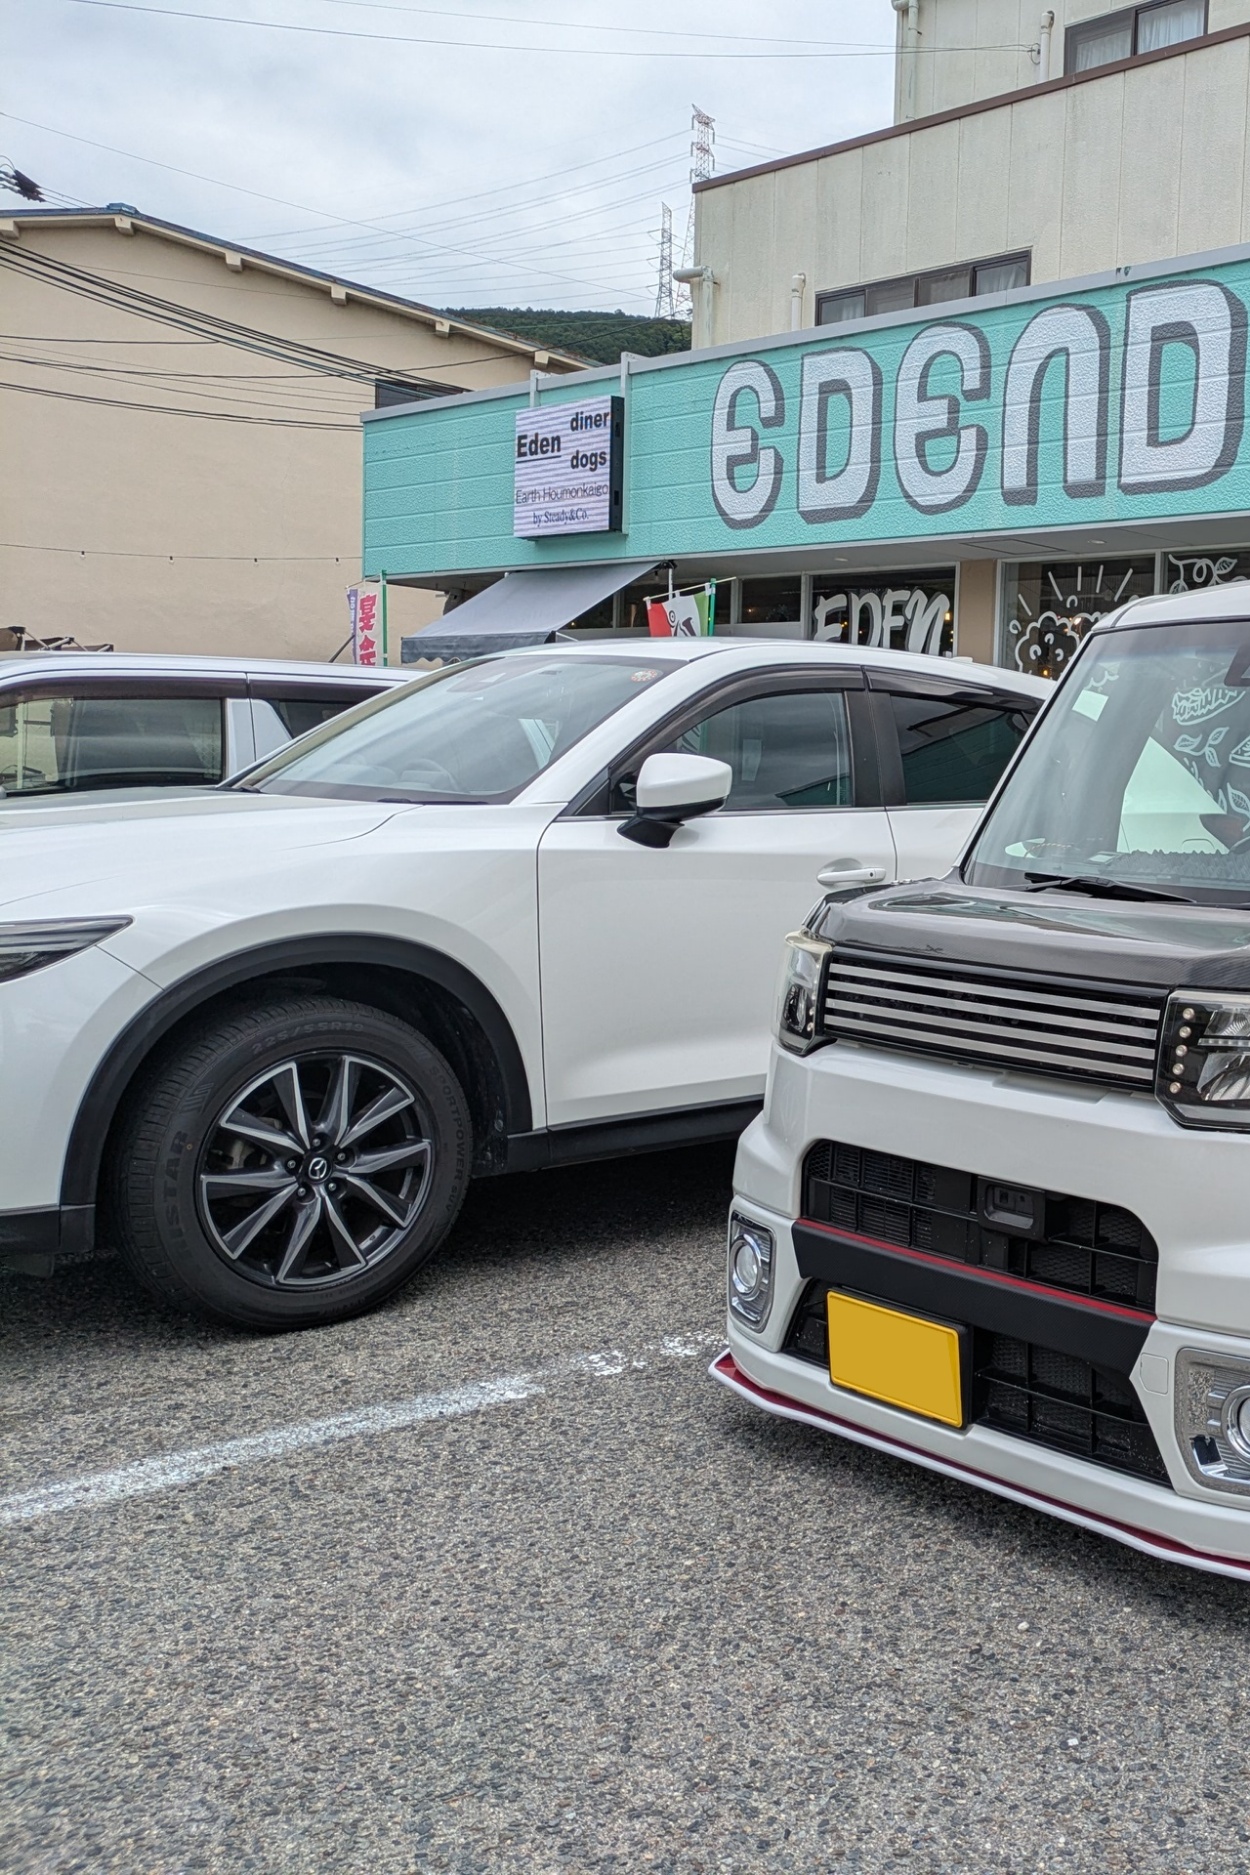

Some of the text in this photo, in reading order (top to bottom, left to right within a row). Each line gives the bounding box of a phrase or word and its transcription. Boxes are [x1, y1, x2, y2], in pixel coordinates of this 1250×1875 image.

[570, 411, 610, 432] diner
[517, 432, 561, 458] Eden
[570, 450, 607, 472] dogs
[516, 488, 541, 504] Earth
[533, 512, 542, 527] by
[251, 1021, 364, 1055] 225/55R19
[429, 1066, 465, 1212] SPORTPOWER SUV
